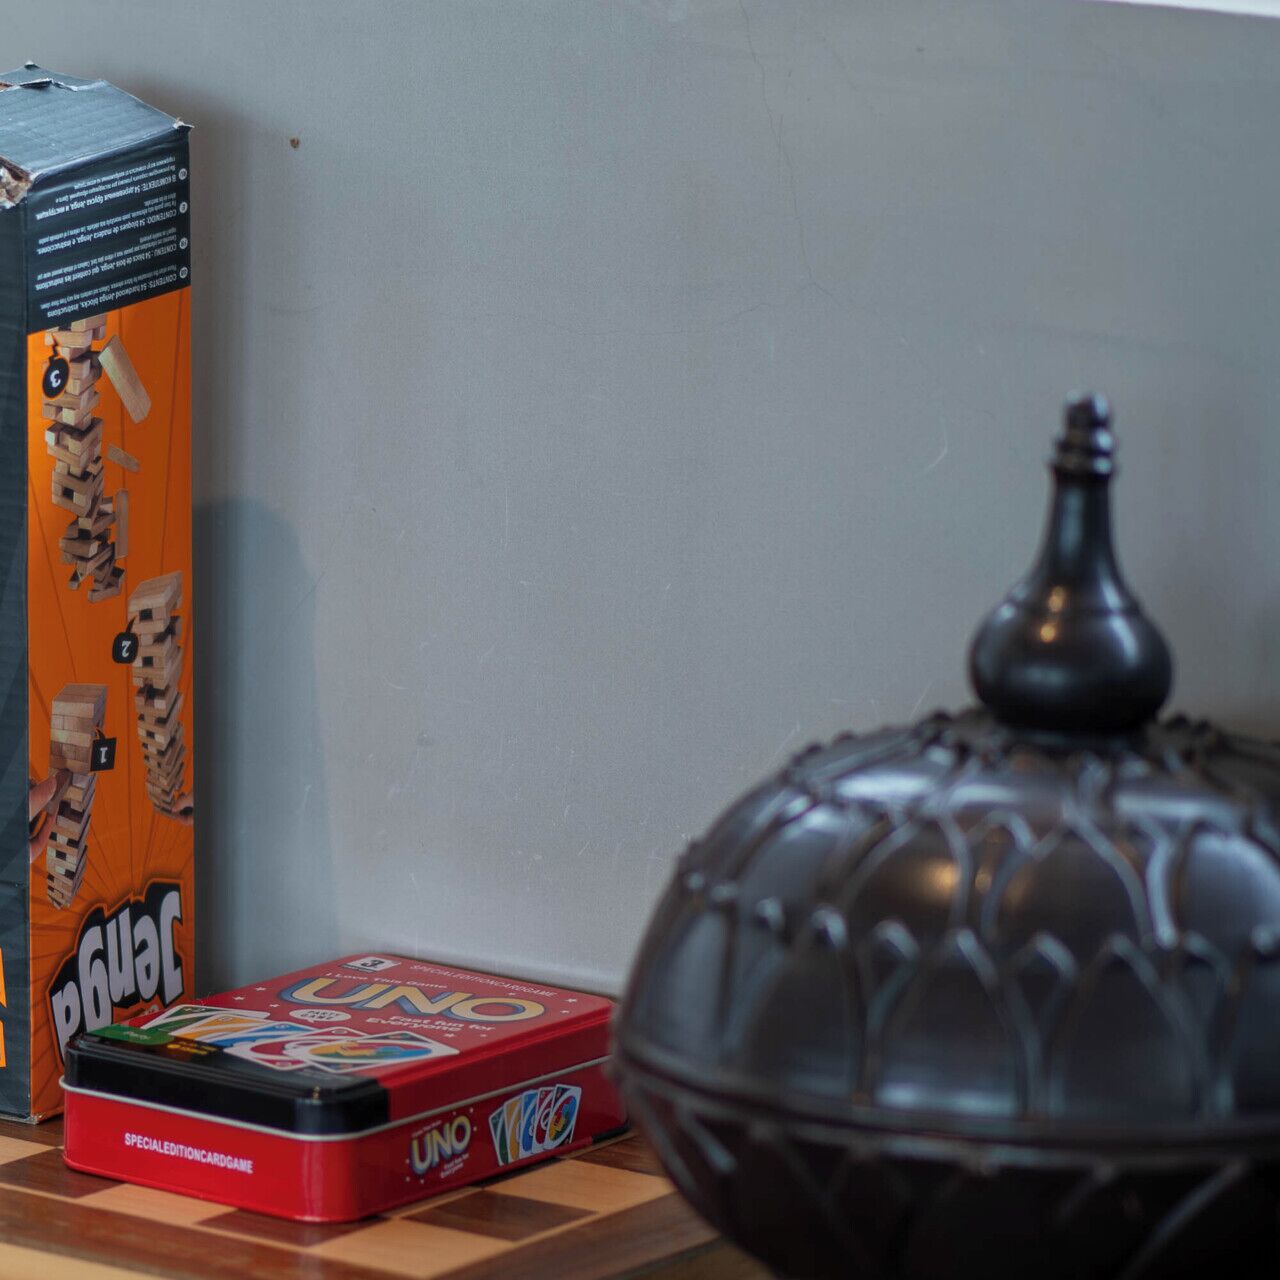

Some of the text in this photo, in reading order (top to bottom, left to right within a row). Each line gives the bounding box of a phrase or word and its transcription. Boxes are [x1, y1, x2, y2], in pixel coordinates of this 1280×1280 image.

[139, 218, 145, 226] 54
[145, 251, 151, 259] 54
[148, 273, 177, 288] CONTENTS:
[99, 293, 115, 303] Jenga
[115, 285, 140, 298] hardwood
[47, 303, 79, 318] instructions
[49, 370, 62, 388] 3
[120, 640, 131, 658] 2
[99, 746, 109, 763] 1
[51, 889, 184, 1064] Jenga
[280, 976, 546, 1022] UNO
[124, 1132, 254, 1174] SPECIALEDITIONCARDGAME
[408, 1114, 472, 1175] UNO
